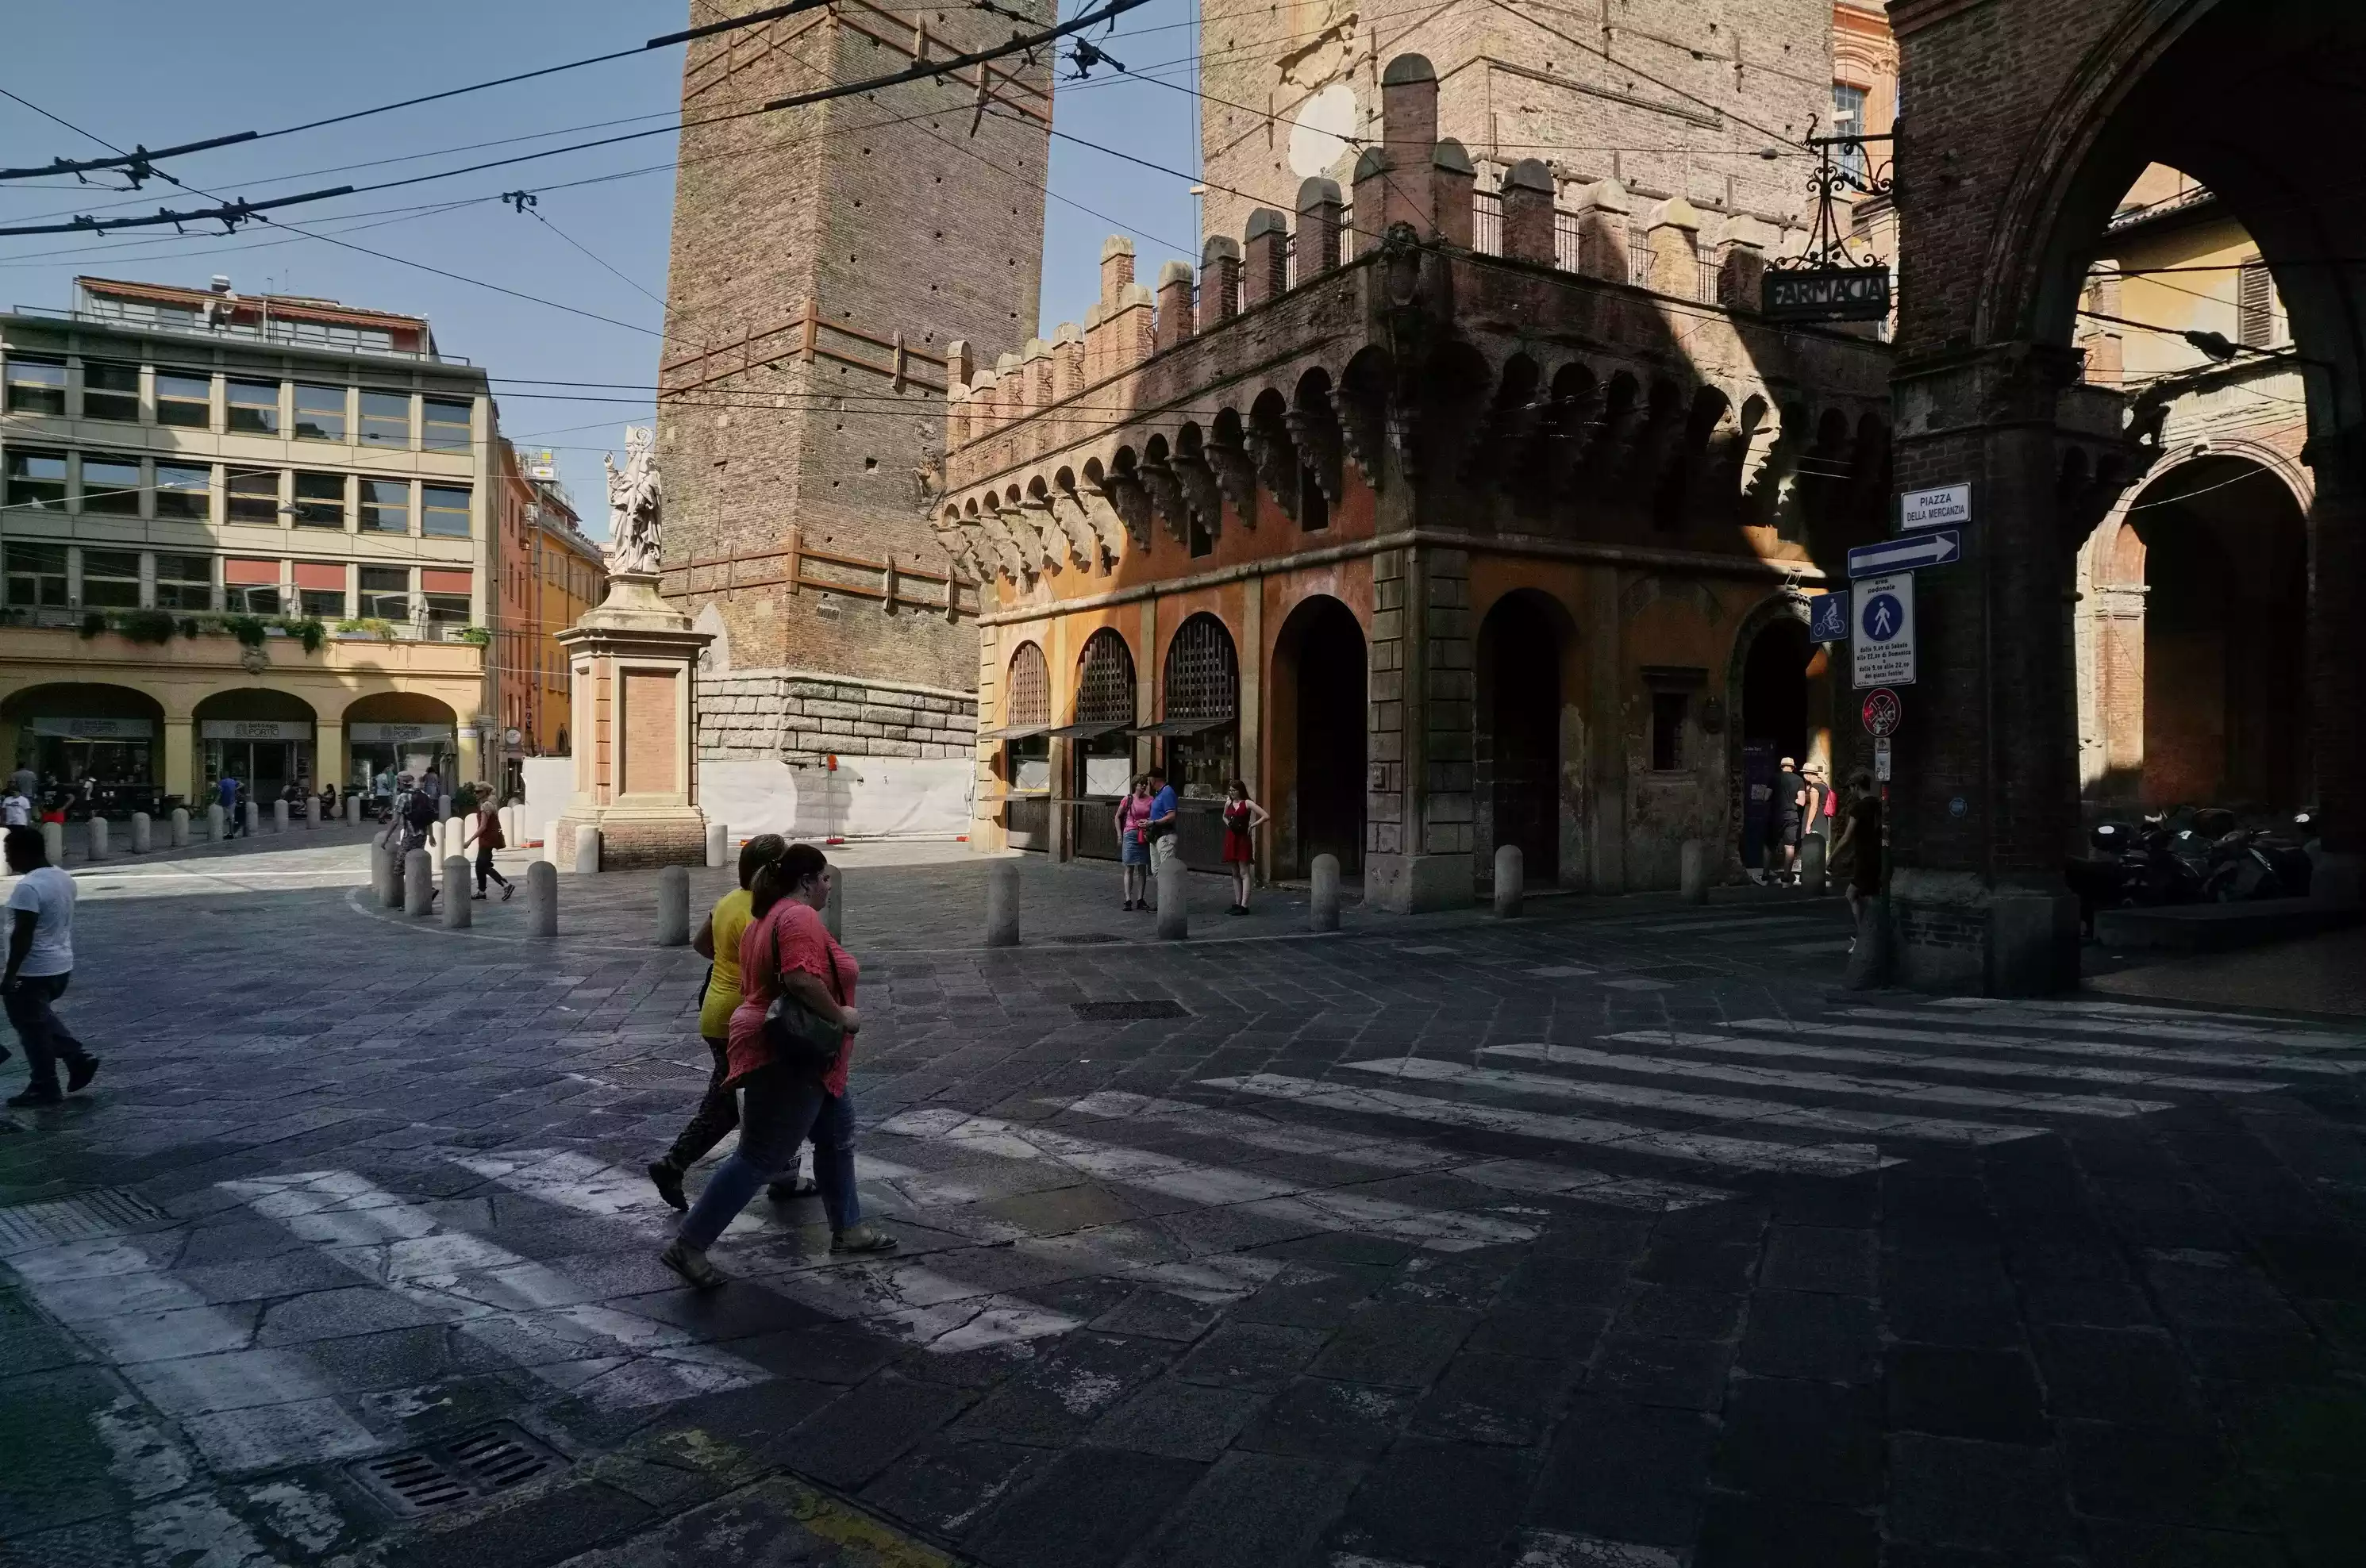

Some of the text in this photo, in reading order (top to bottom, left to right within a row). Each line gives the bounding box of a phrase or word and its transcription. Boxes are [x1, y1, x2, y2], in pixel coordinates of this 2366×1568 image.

[1773, 279, 1885, 306] FARMACIA
[1920, 493, 1952, 506] PIAZZA
[1906, 505, 1964, 521] DELLA MERCANZIA
[1868, 584, 1896, 594] pedonale
